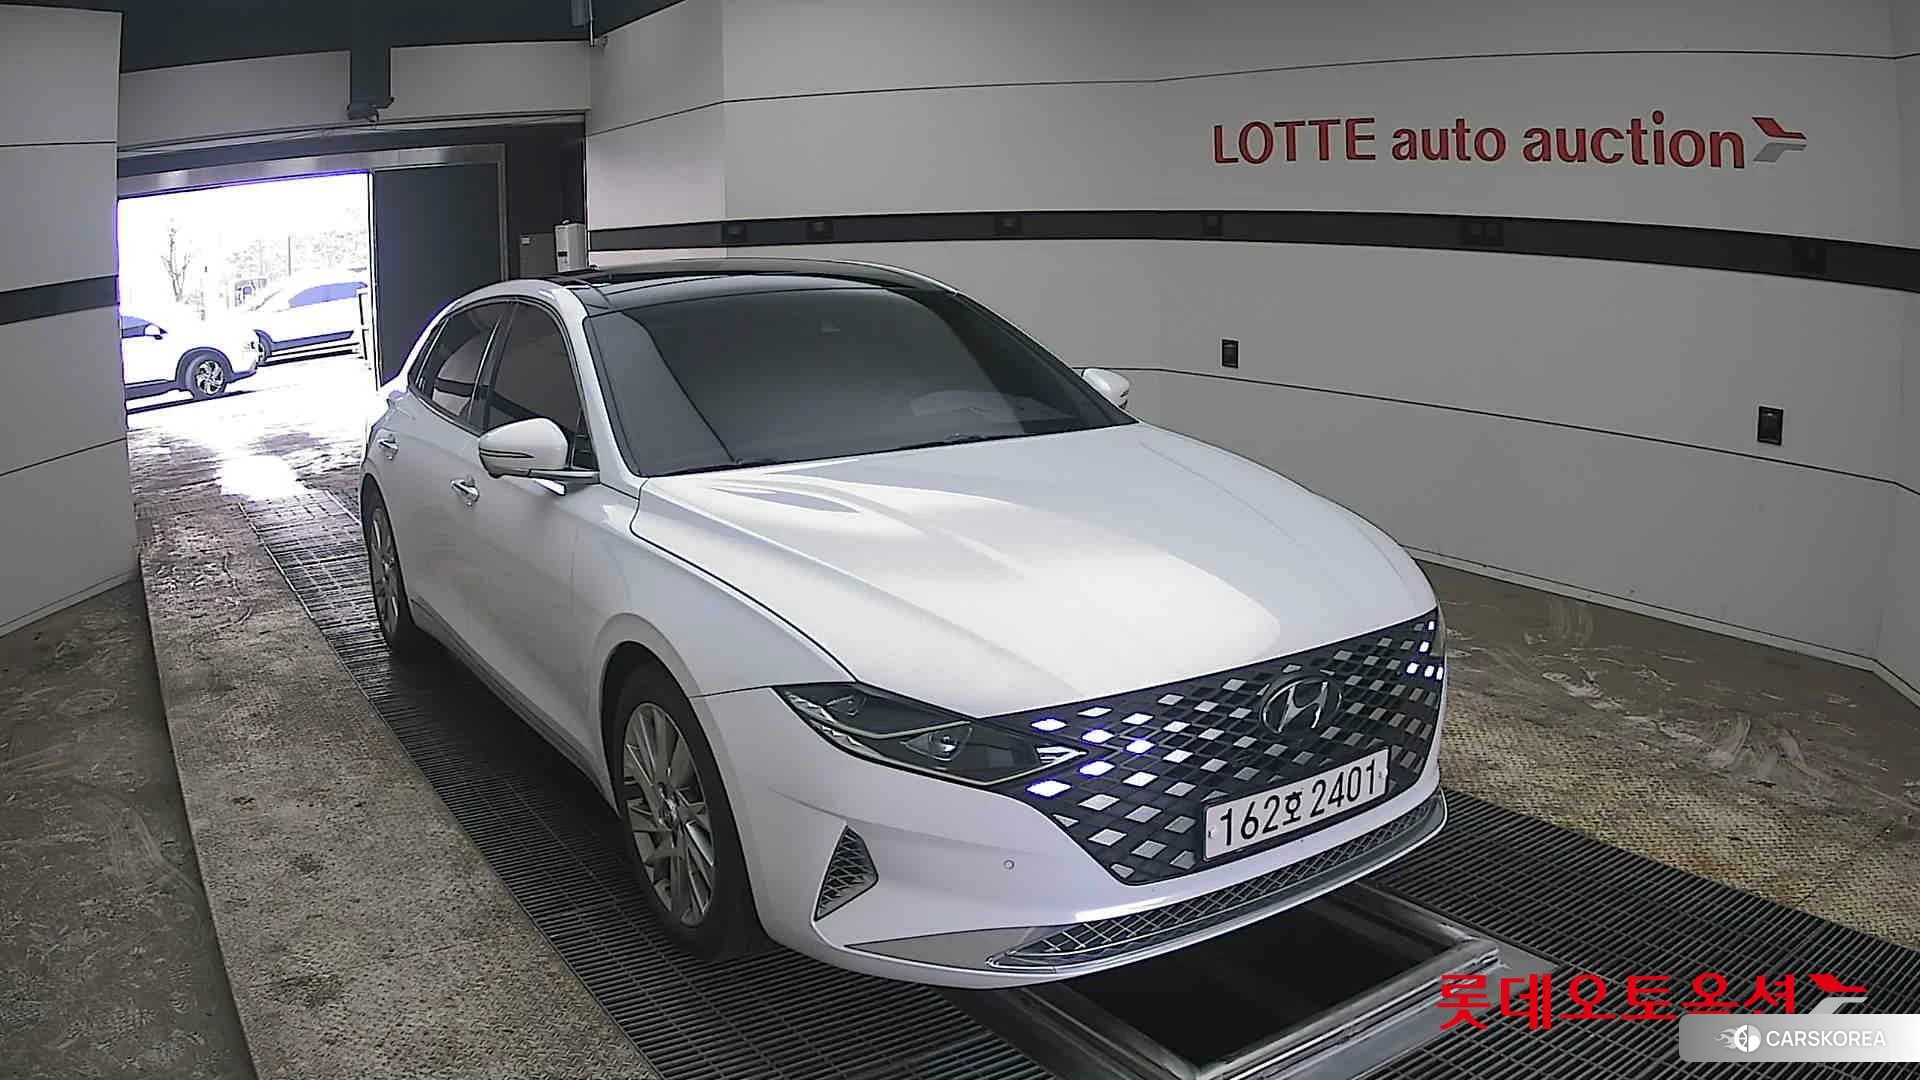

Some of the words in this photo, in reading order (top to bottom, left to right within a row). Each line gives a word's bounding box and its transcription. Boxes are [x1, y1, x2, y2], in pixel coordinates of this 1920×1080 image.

[1213, 116, 1377, 165] LOTTE
[1391, 117, 1507, 163] auto
[1522, 109, 1746, 169] auction
[1219, 791, 1303, 847] 162호
[1309, 758, 1377, 818] 2401
